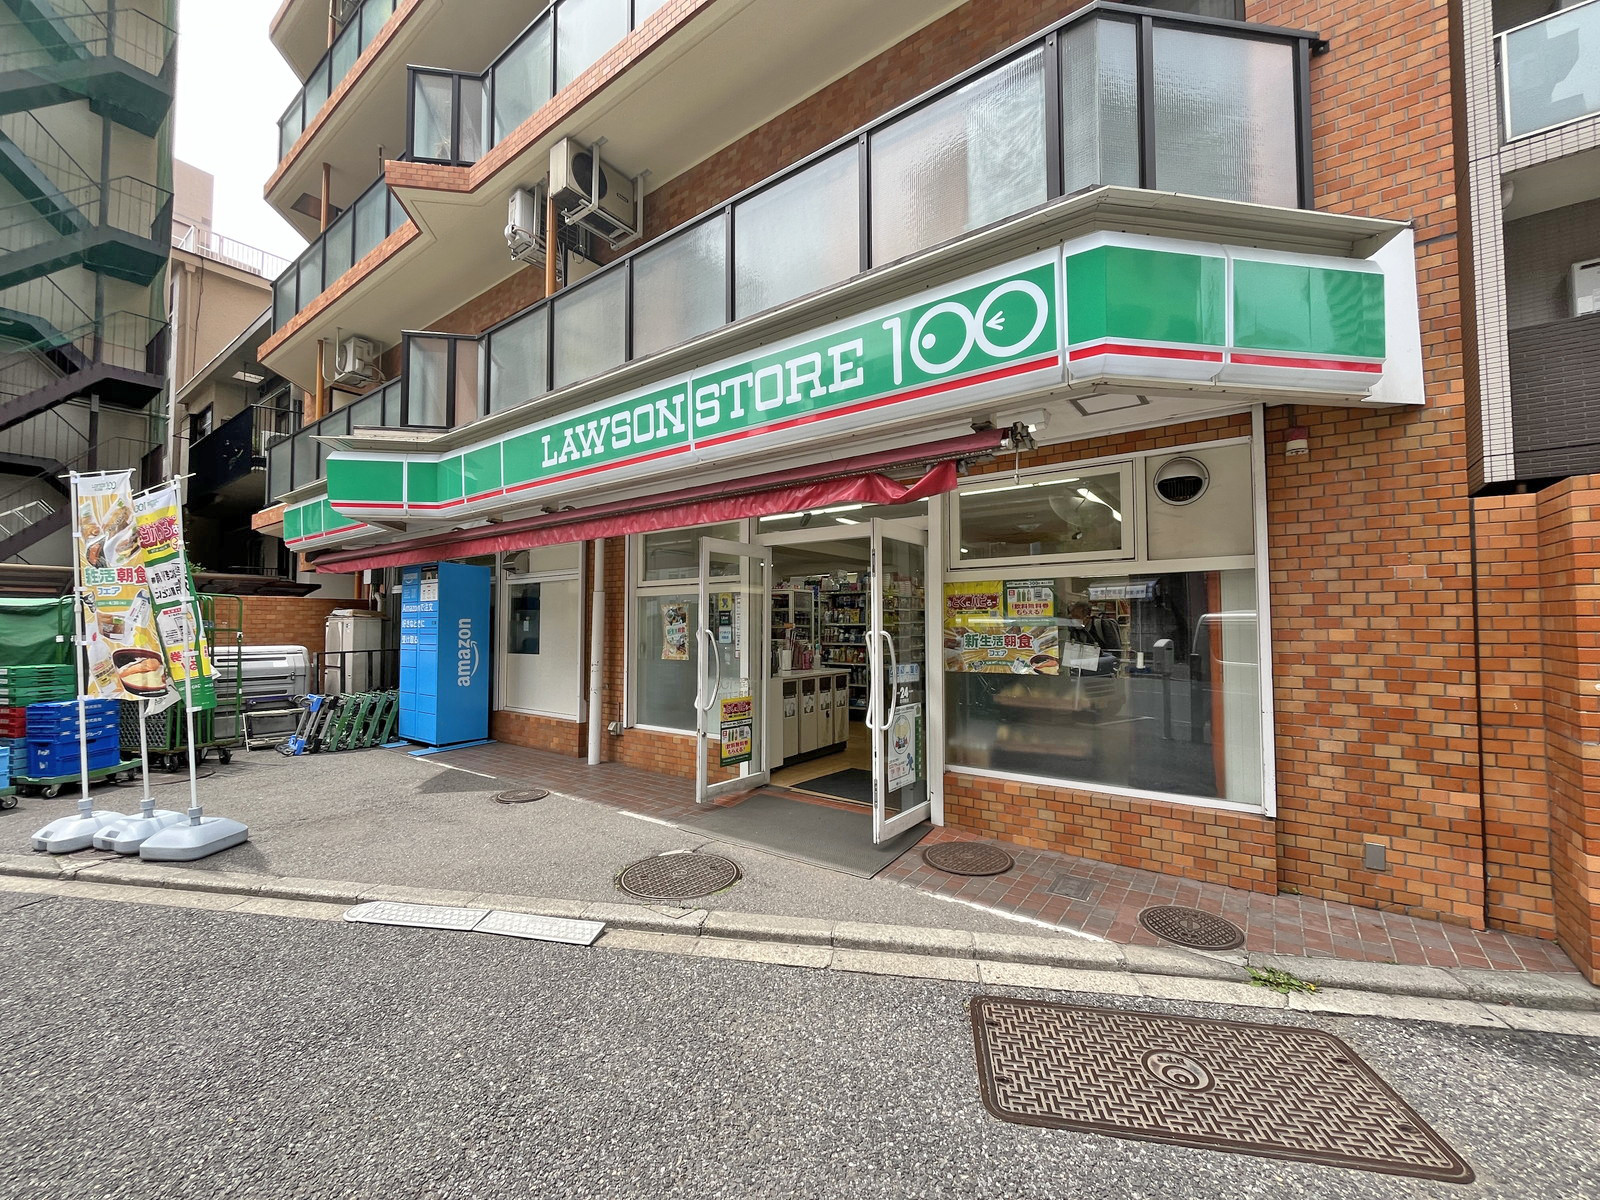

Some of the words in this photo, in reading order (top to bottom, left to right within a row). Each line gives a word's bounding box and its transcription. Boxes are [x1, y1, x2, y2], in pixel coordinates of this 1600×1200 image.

[541, 393, 687, 469] LAWSON
[695, 338, 864, 427] STORE
[882, 279, 1049, 386] 100
[457, 618, 472, 687] amazon
[964, 633, 1033, 649] 新生活朝食
[899, 686, 909, 699] 24
